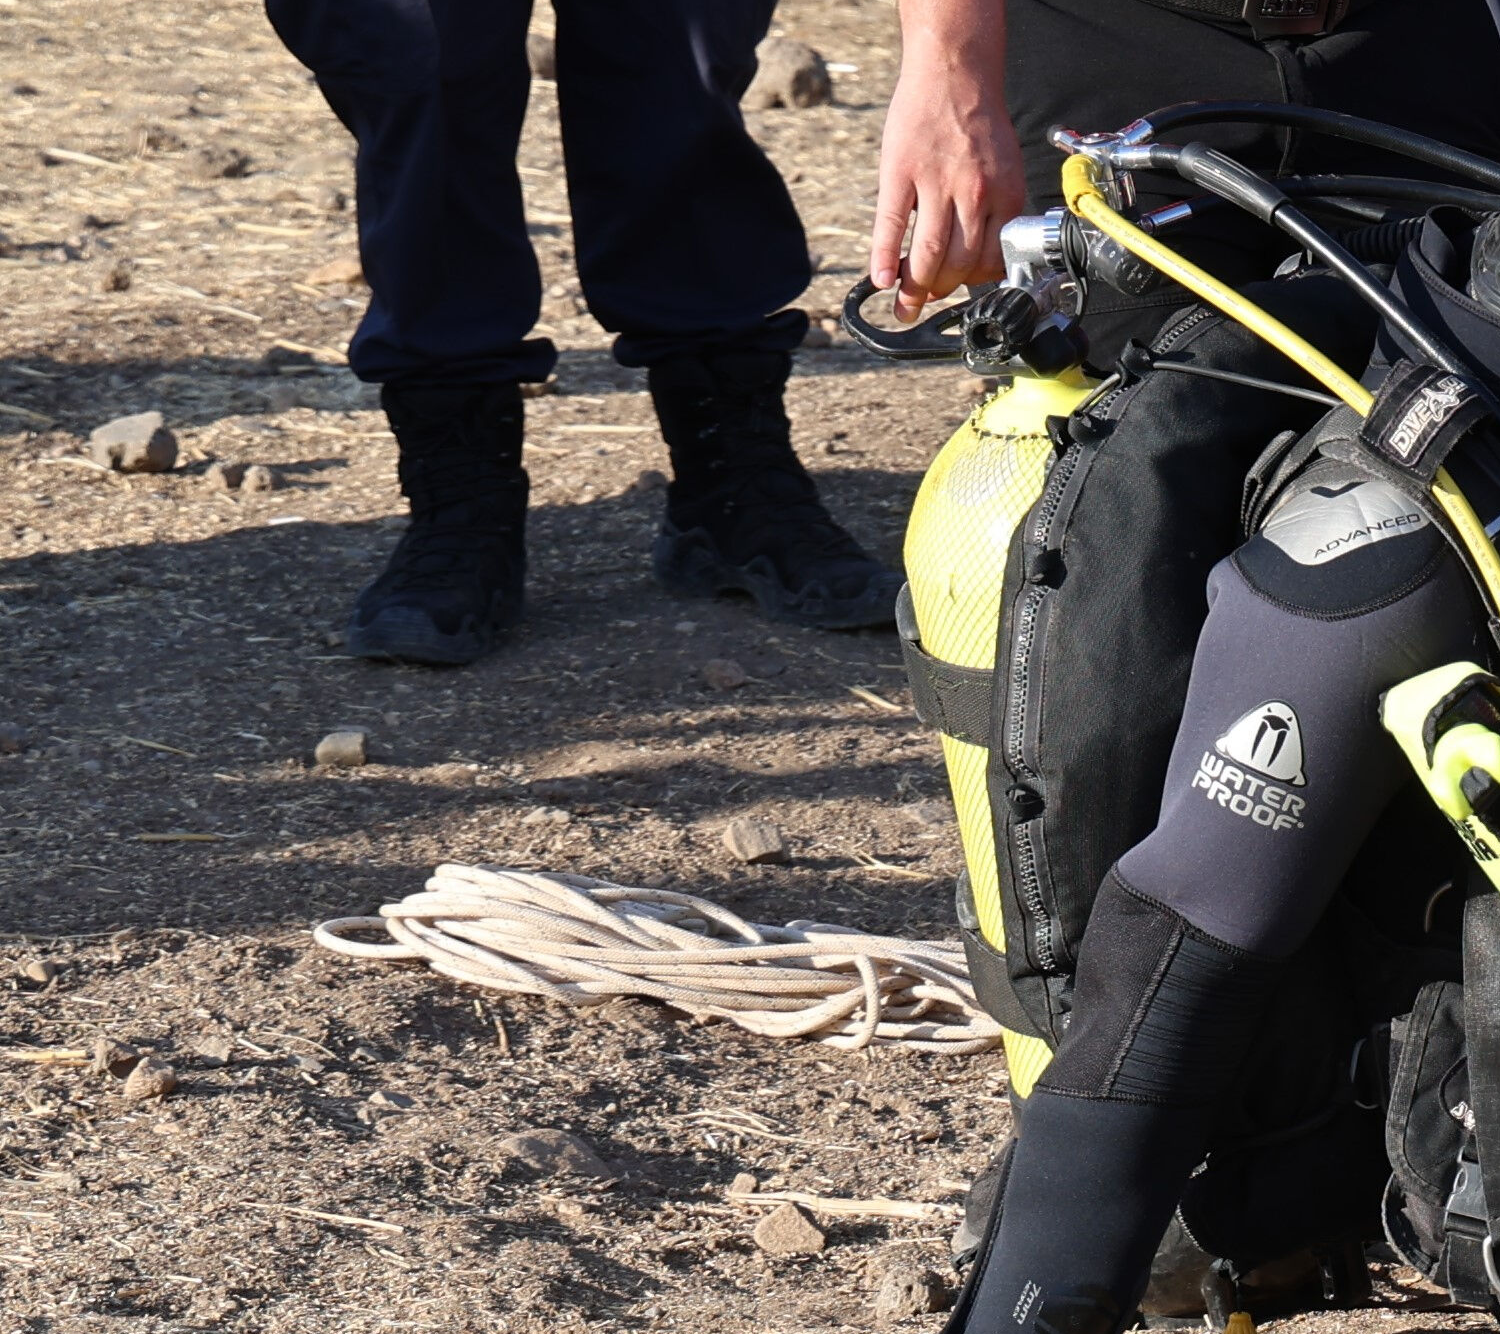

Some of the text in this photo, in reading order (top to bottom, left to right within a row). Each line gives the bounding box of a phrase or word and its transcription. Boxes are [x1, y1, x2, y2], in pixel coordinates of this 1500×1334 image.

[1313, 513, 1421, 558] ADVANCED
[1191, 770, 1299, 830] PROOF
[1200, 751, 1306, 817] WATER
